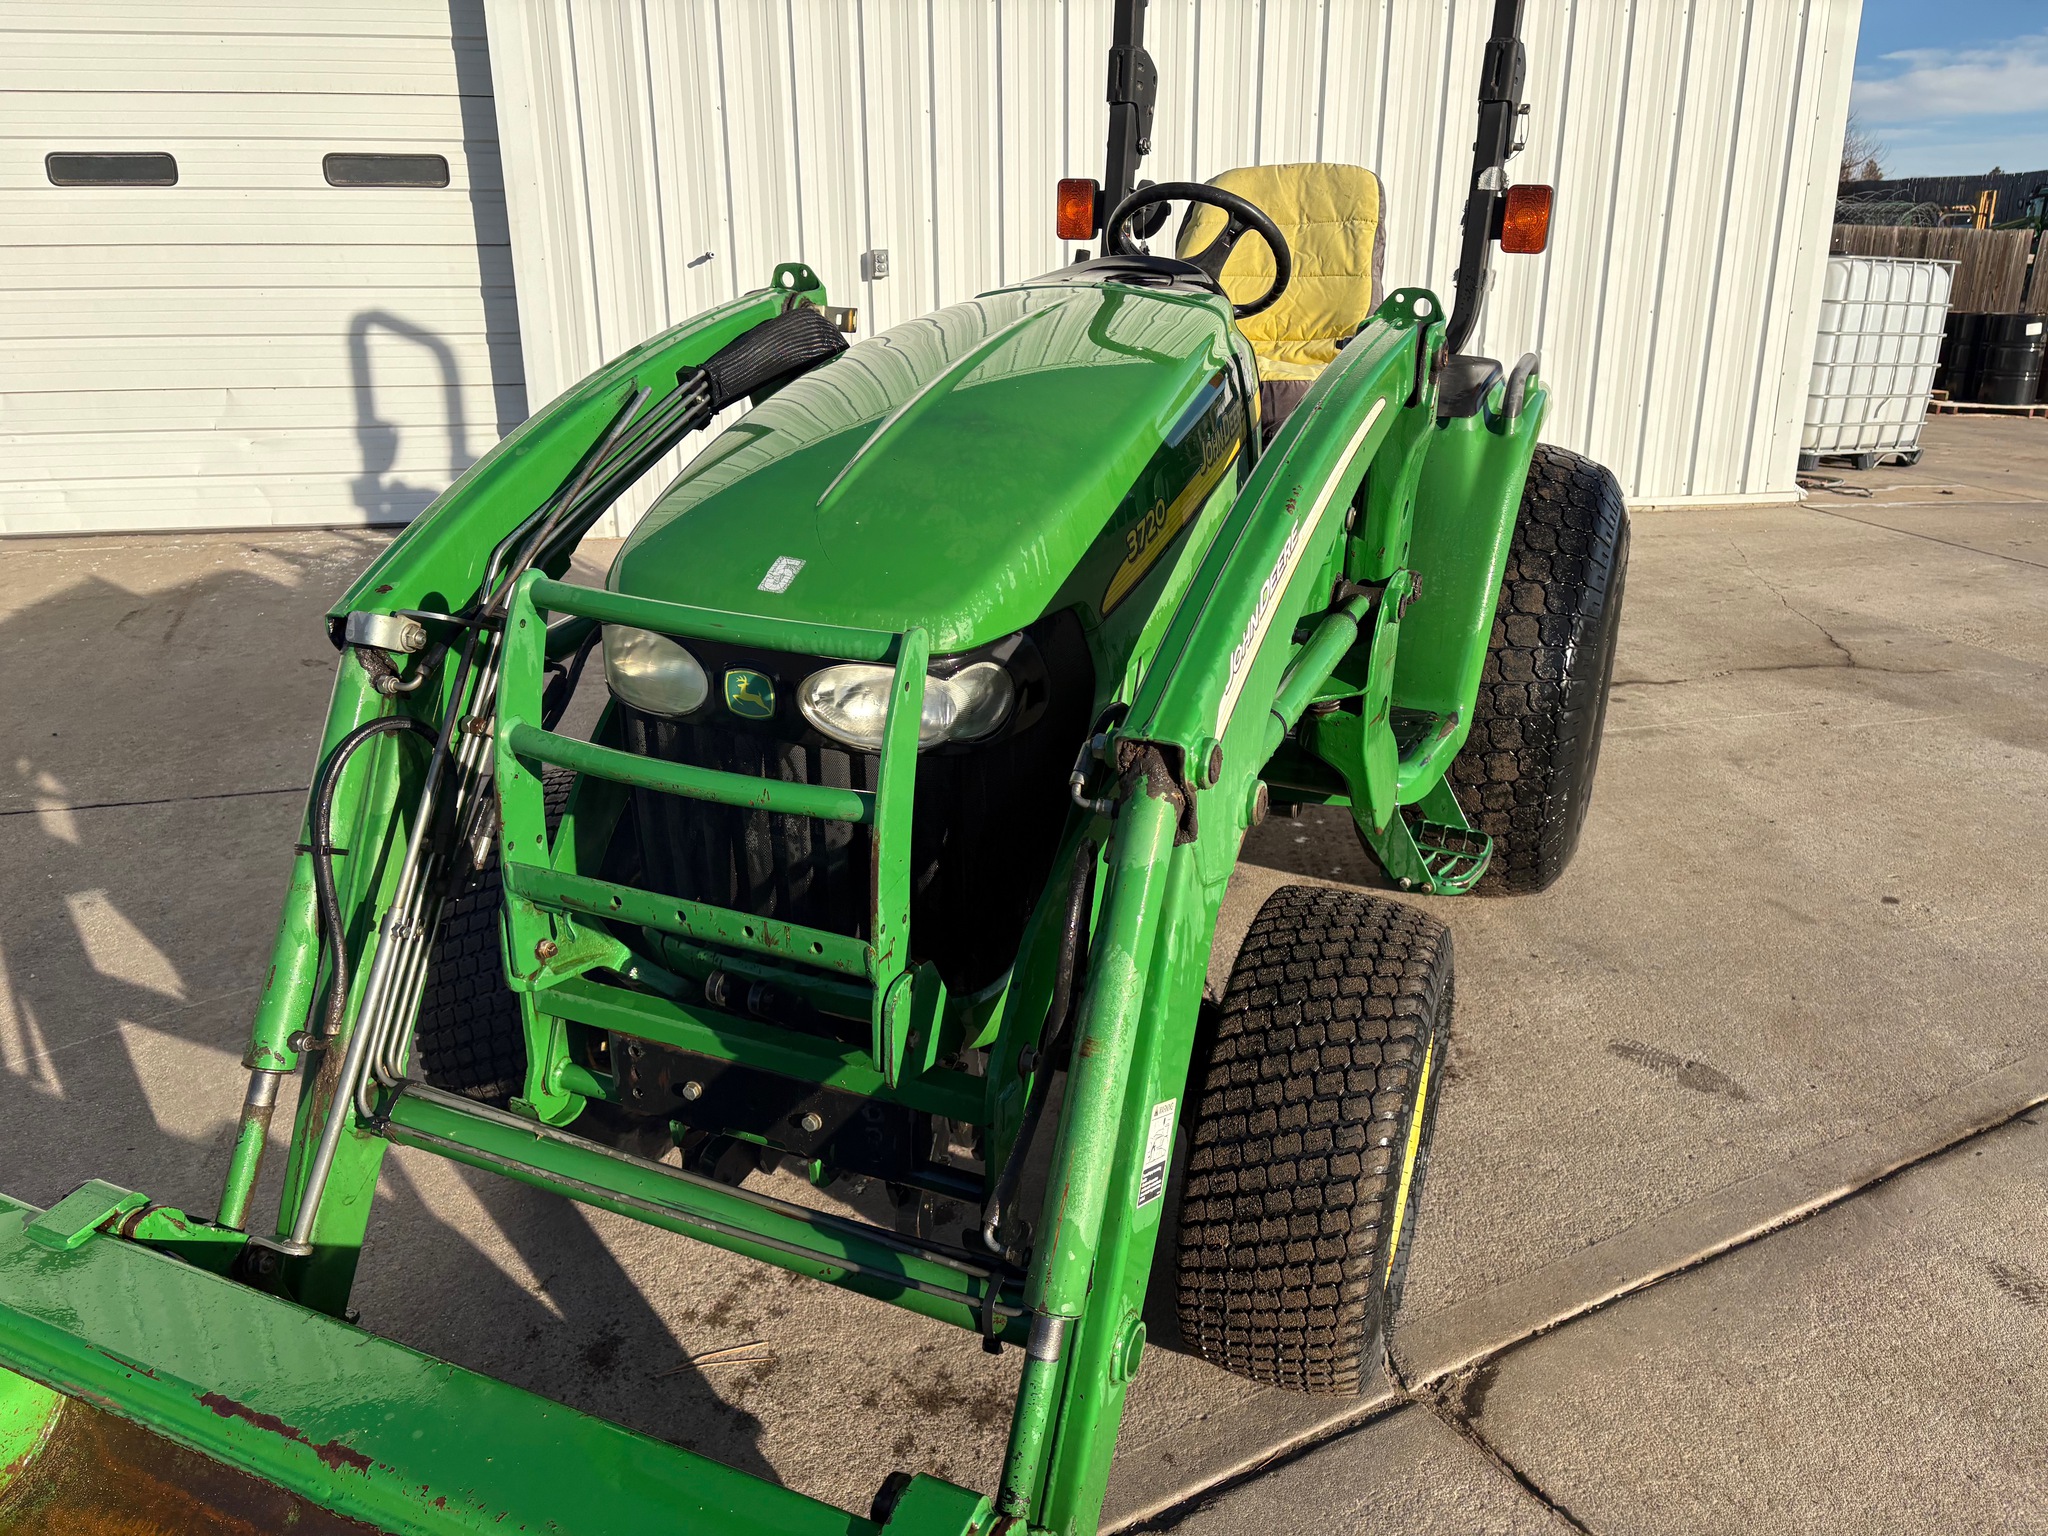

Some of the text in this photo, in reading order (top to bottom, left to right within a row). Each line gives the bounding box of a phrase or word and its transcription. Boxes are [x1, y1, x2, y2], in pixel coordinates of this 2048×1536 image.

[1201, 424, 1225, 473] JOHN
[1127, 498, 1165, 561] 3720
[1225, 518, 1299, 695] JOHN DEERE
